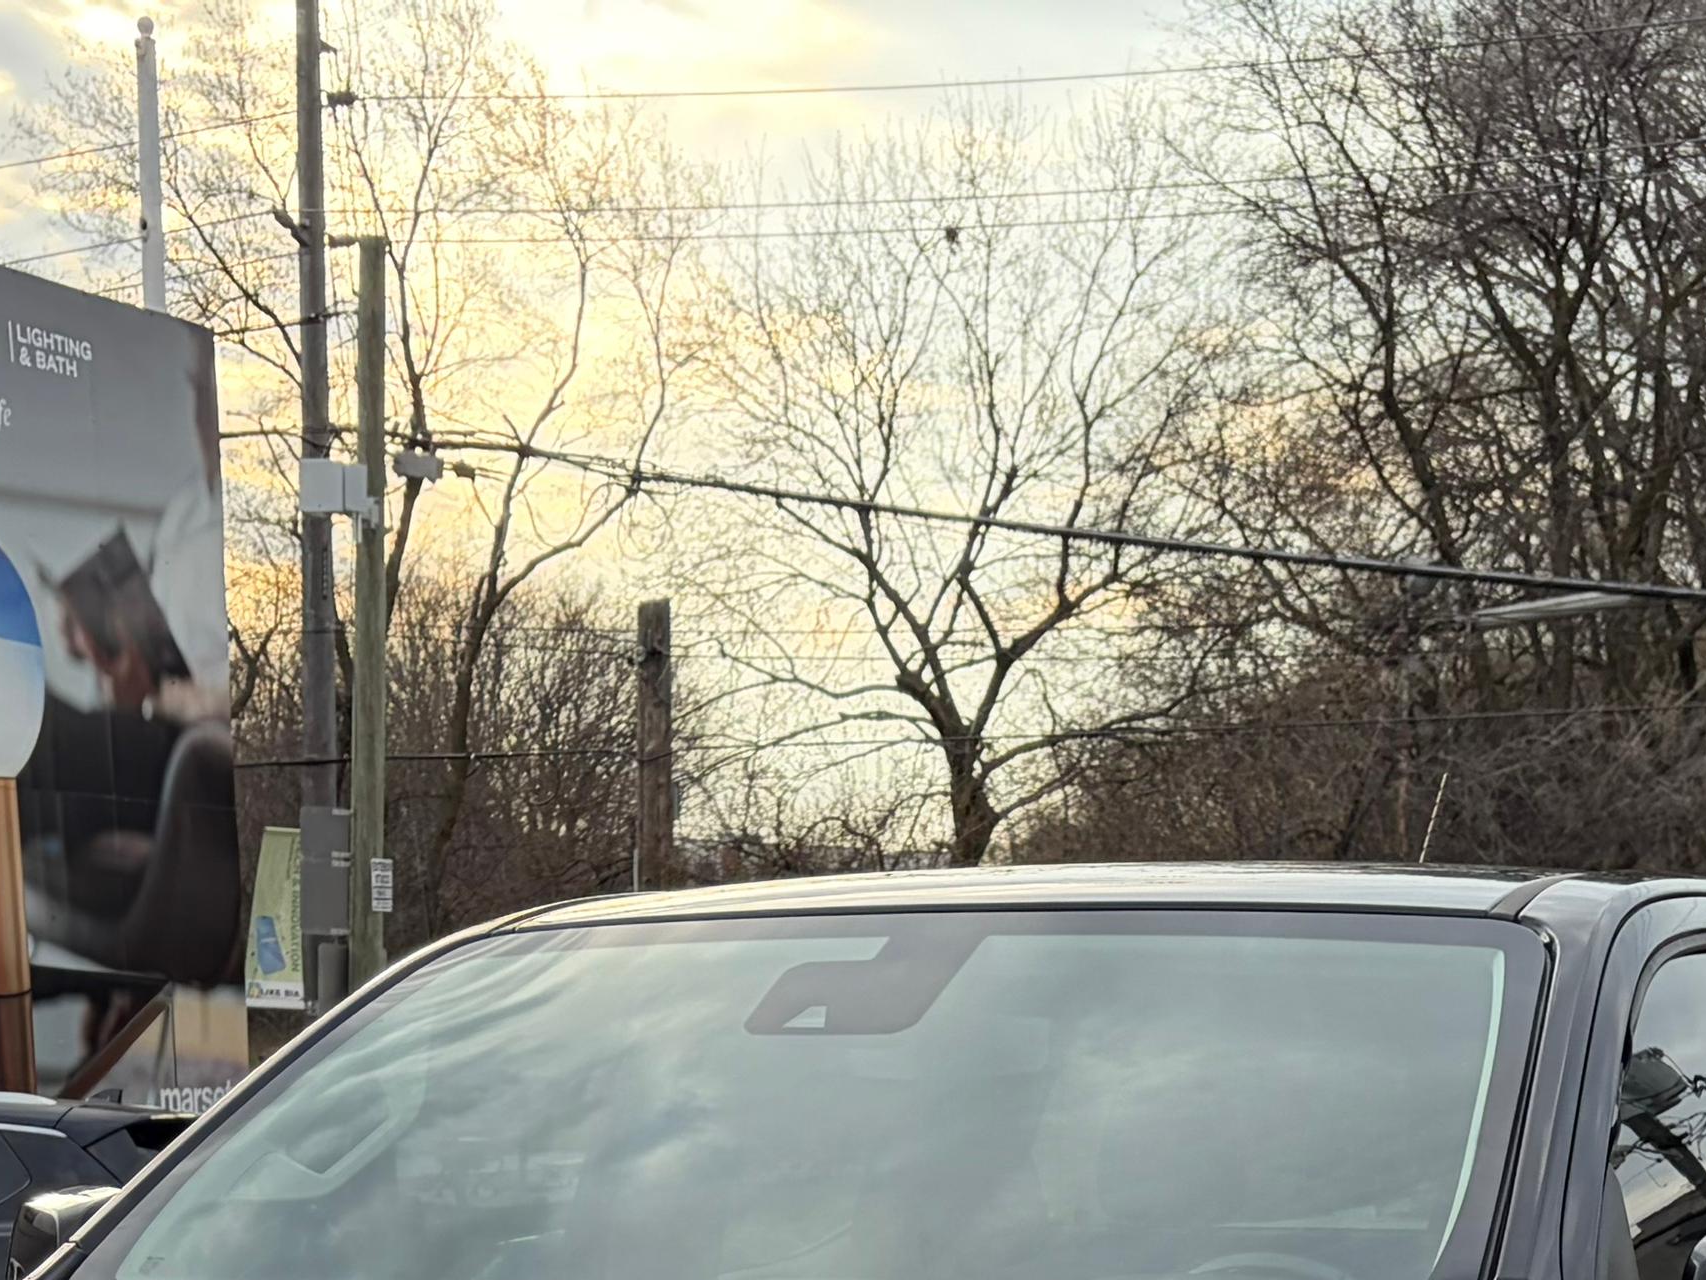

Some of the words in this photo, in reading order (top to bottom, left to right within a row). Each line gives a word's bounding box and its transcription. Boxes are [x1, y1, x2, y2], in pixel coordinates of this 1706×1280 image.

[16, 323, 92, 361] LIGHTING
[19, 345, 32, 368] &
[35, 350, 78, 378] BATH
